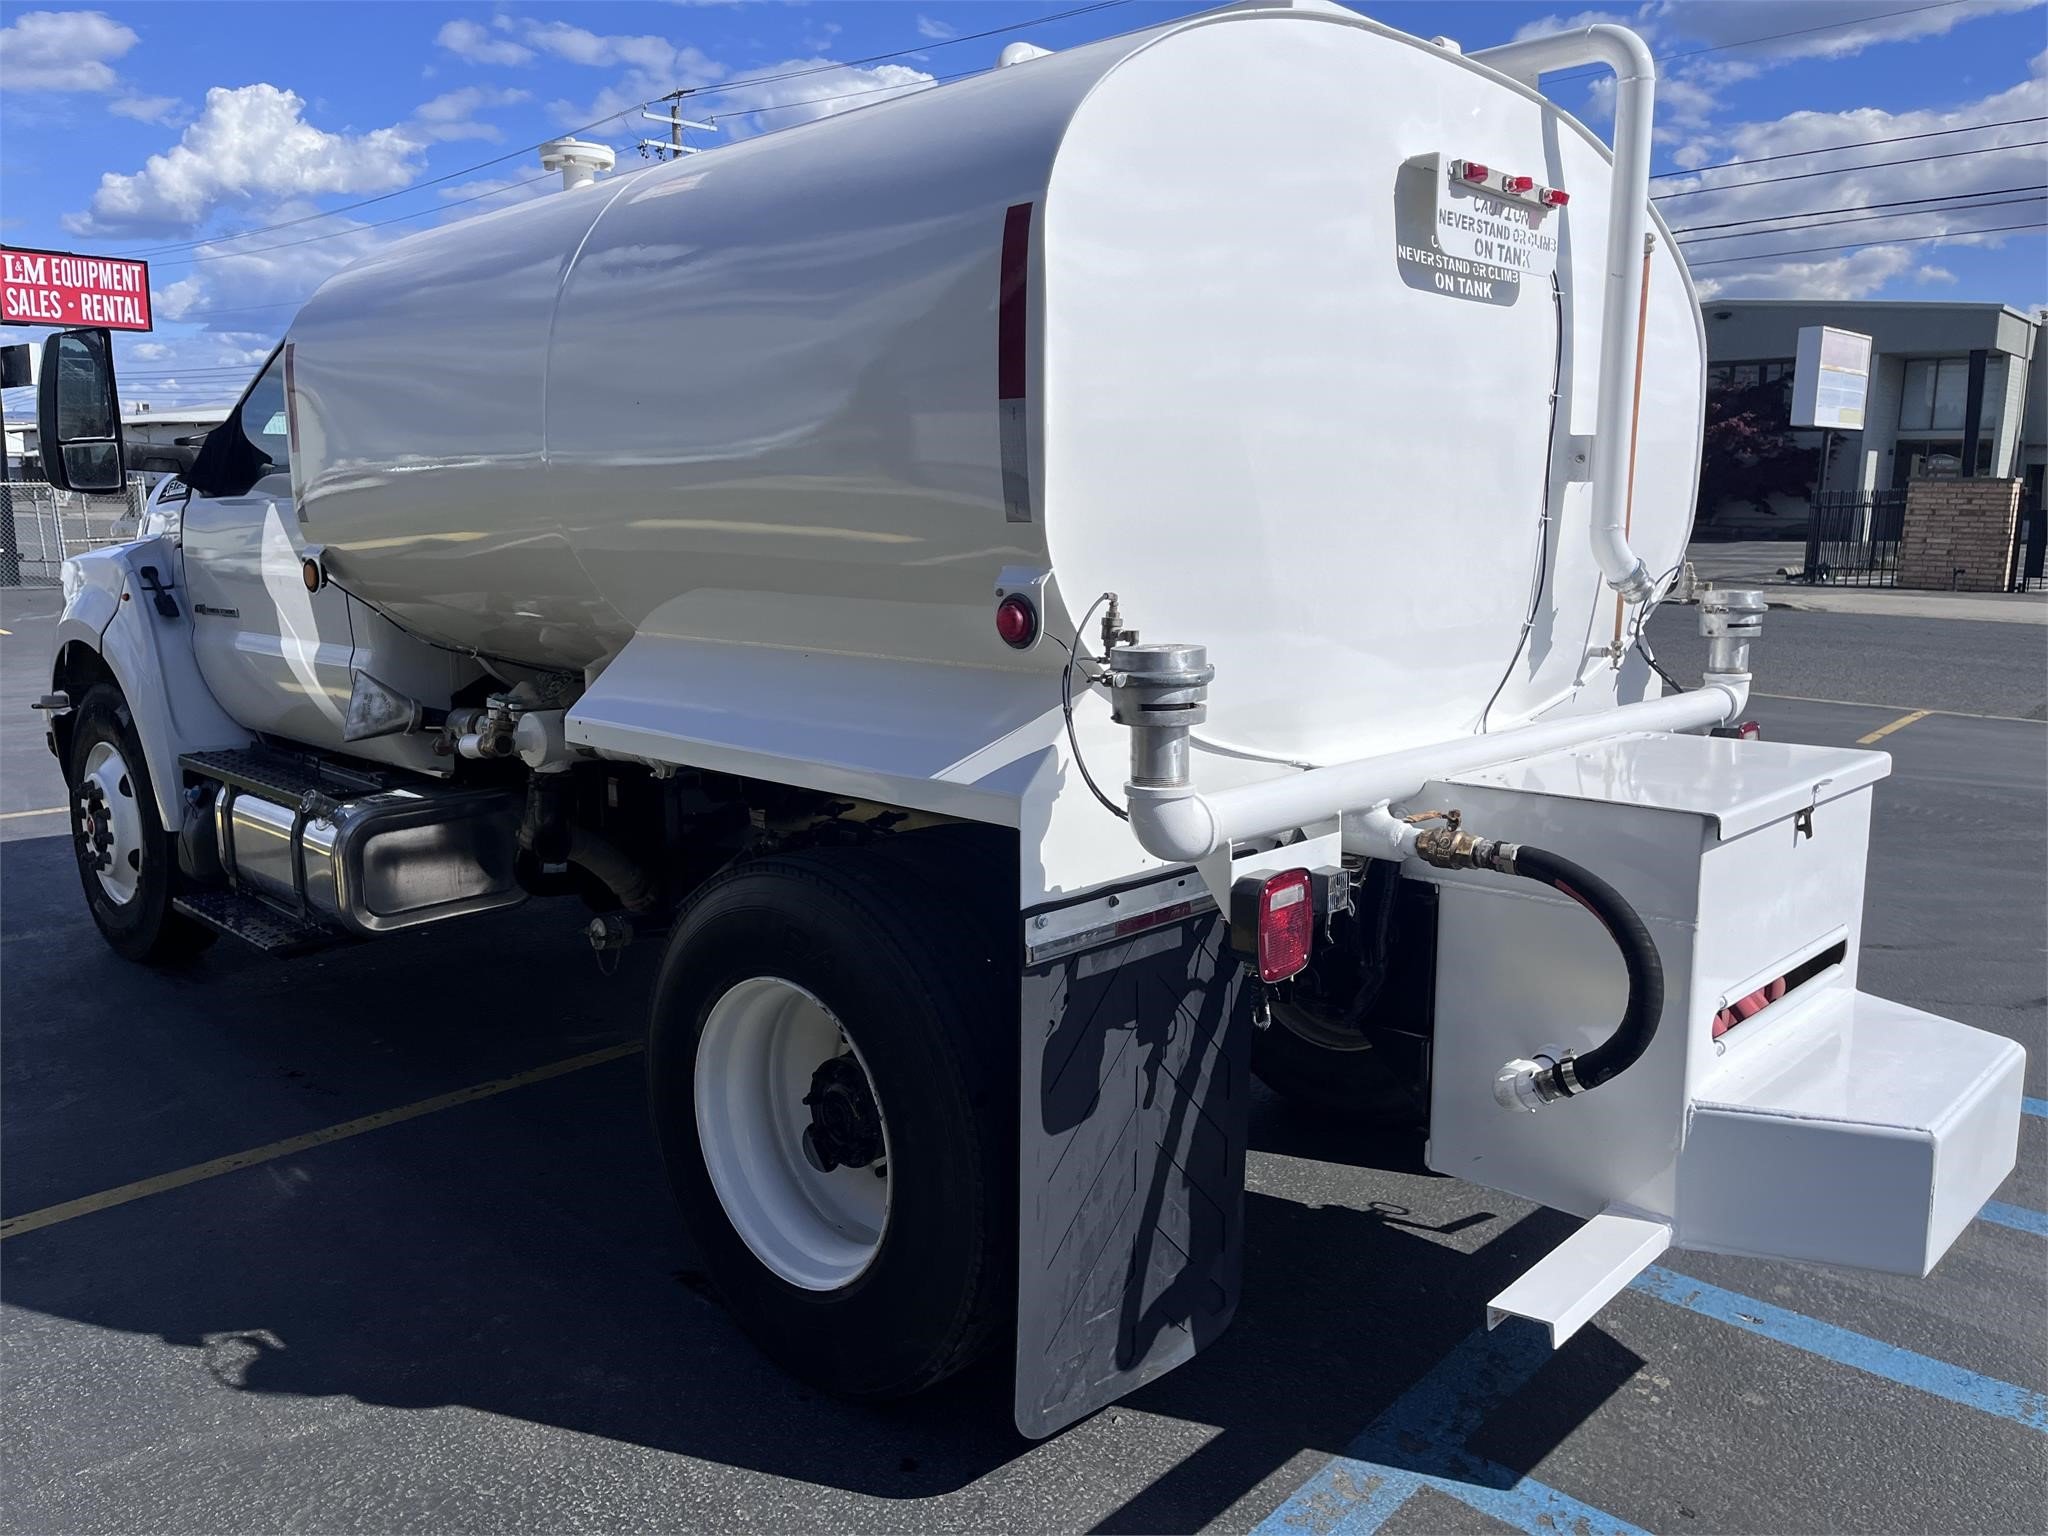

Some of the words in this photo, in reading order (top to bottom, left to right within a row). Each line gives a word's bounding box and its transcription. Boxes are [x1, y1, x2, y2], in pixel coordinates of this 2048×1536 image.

[1439, 208, 1475, 232] NEVER
[1477, 219, 1510, 241] STAND
[1513, 228, 1526, 245] OR
[1398, 244, 1435, 266] NEVER
[1436, 256, 1470, 274] STAND
[1472, 262, 1487, 278] OR
[1474, 238, 1493, 260] ON
[1497, 243, 1531, 269] TANK
[2, 254, 48, 286] L&M
[51, 257, 141, 293] EQUIPMENT
[1435, 272, 1454, 292] ON
[1457, 278, 1493, 299] TANK
[6, 287, 63, 319] SALES
[81, 293, 145, 324] RENTAL
